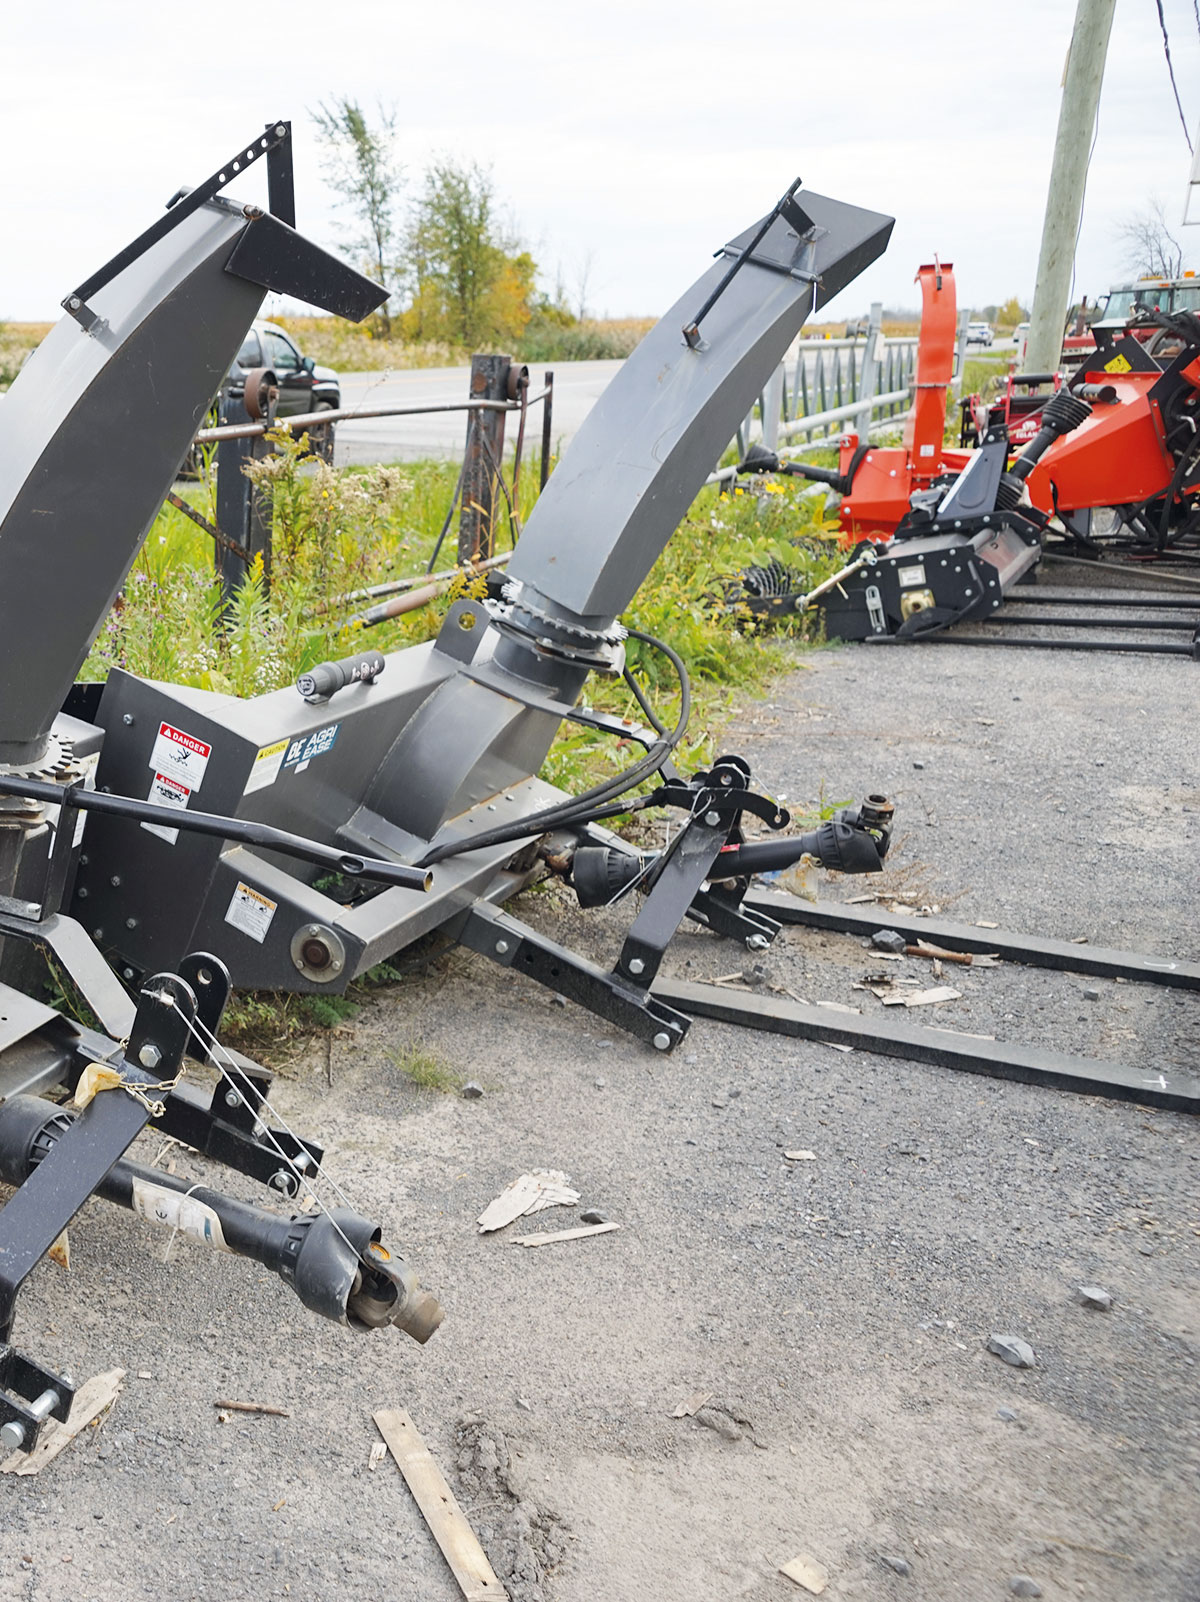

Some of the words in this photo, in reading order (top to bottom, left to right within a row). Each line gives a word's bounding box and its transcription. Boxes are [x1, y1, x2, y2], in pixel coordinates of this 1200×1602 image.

[172, 732, 206, 755] DANGER
[307, 724, 338, 748] AGRI
[287, 738, 307, 761] BE
[302, 739, 333, 761] EASE
